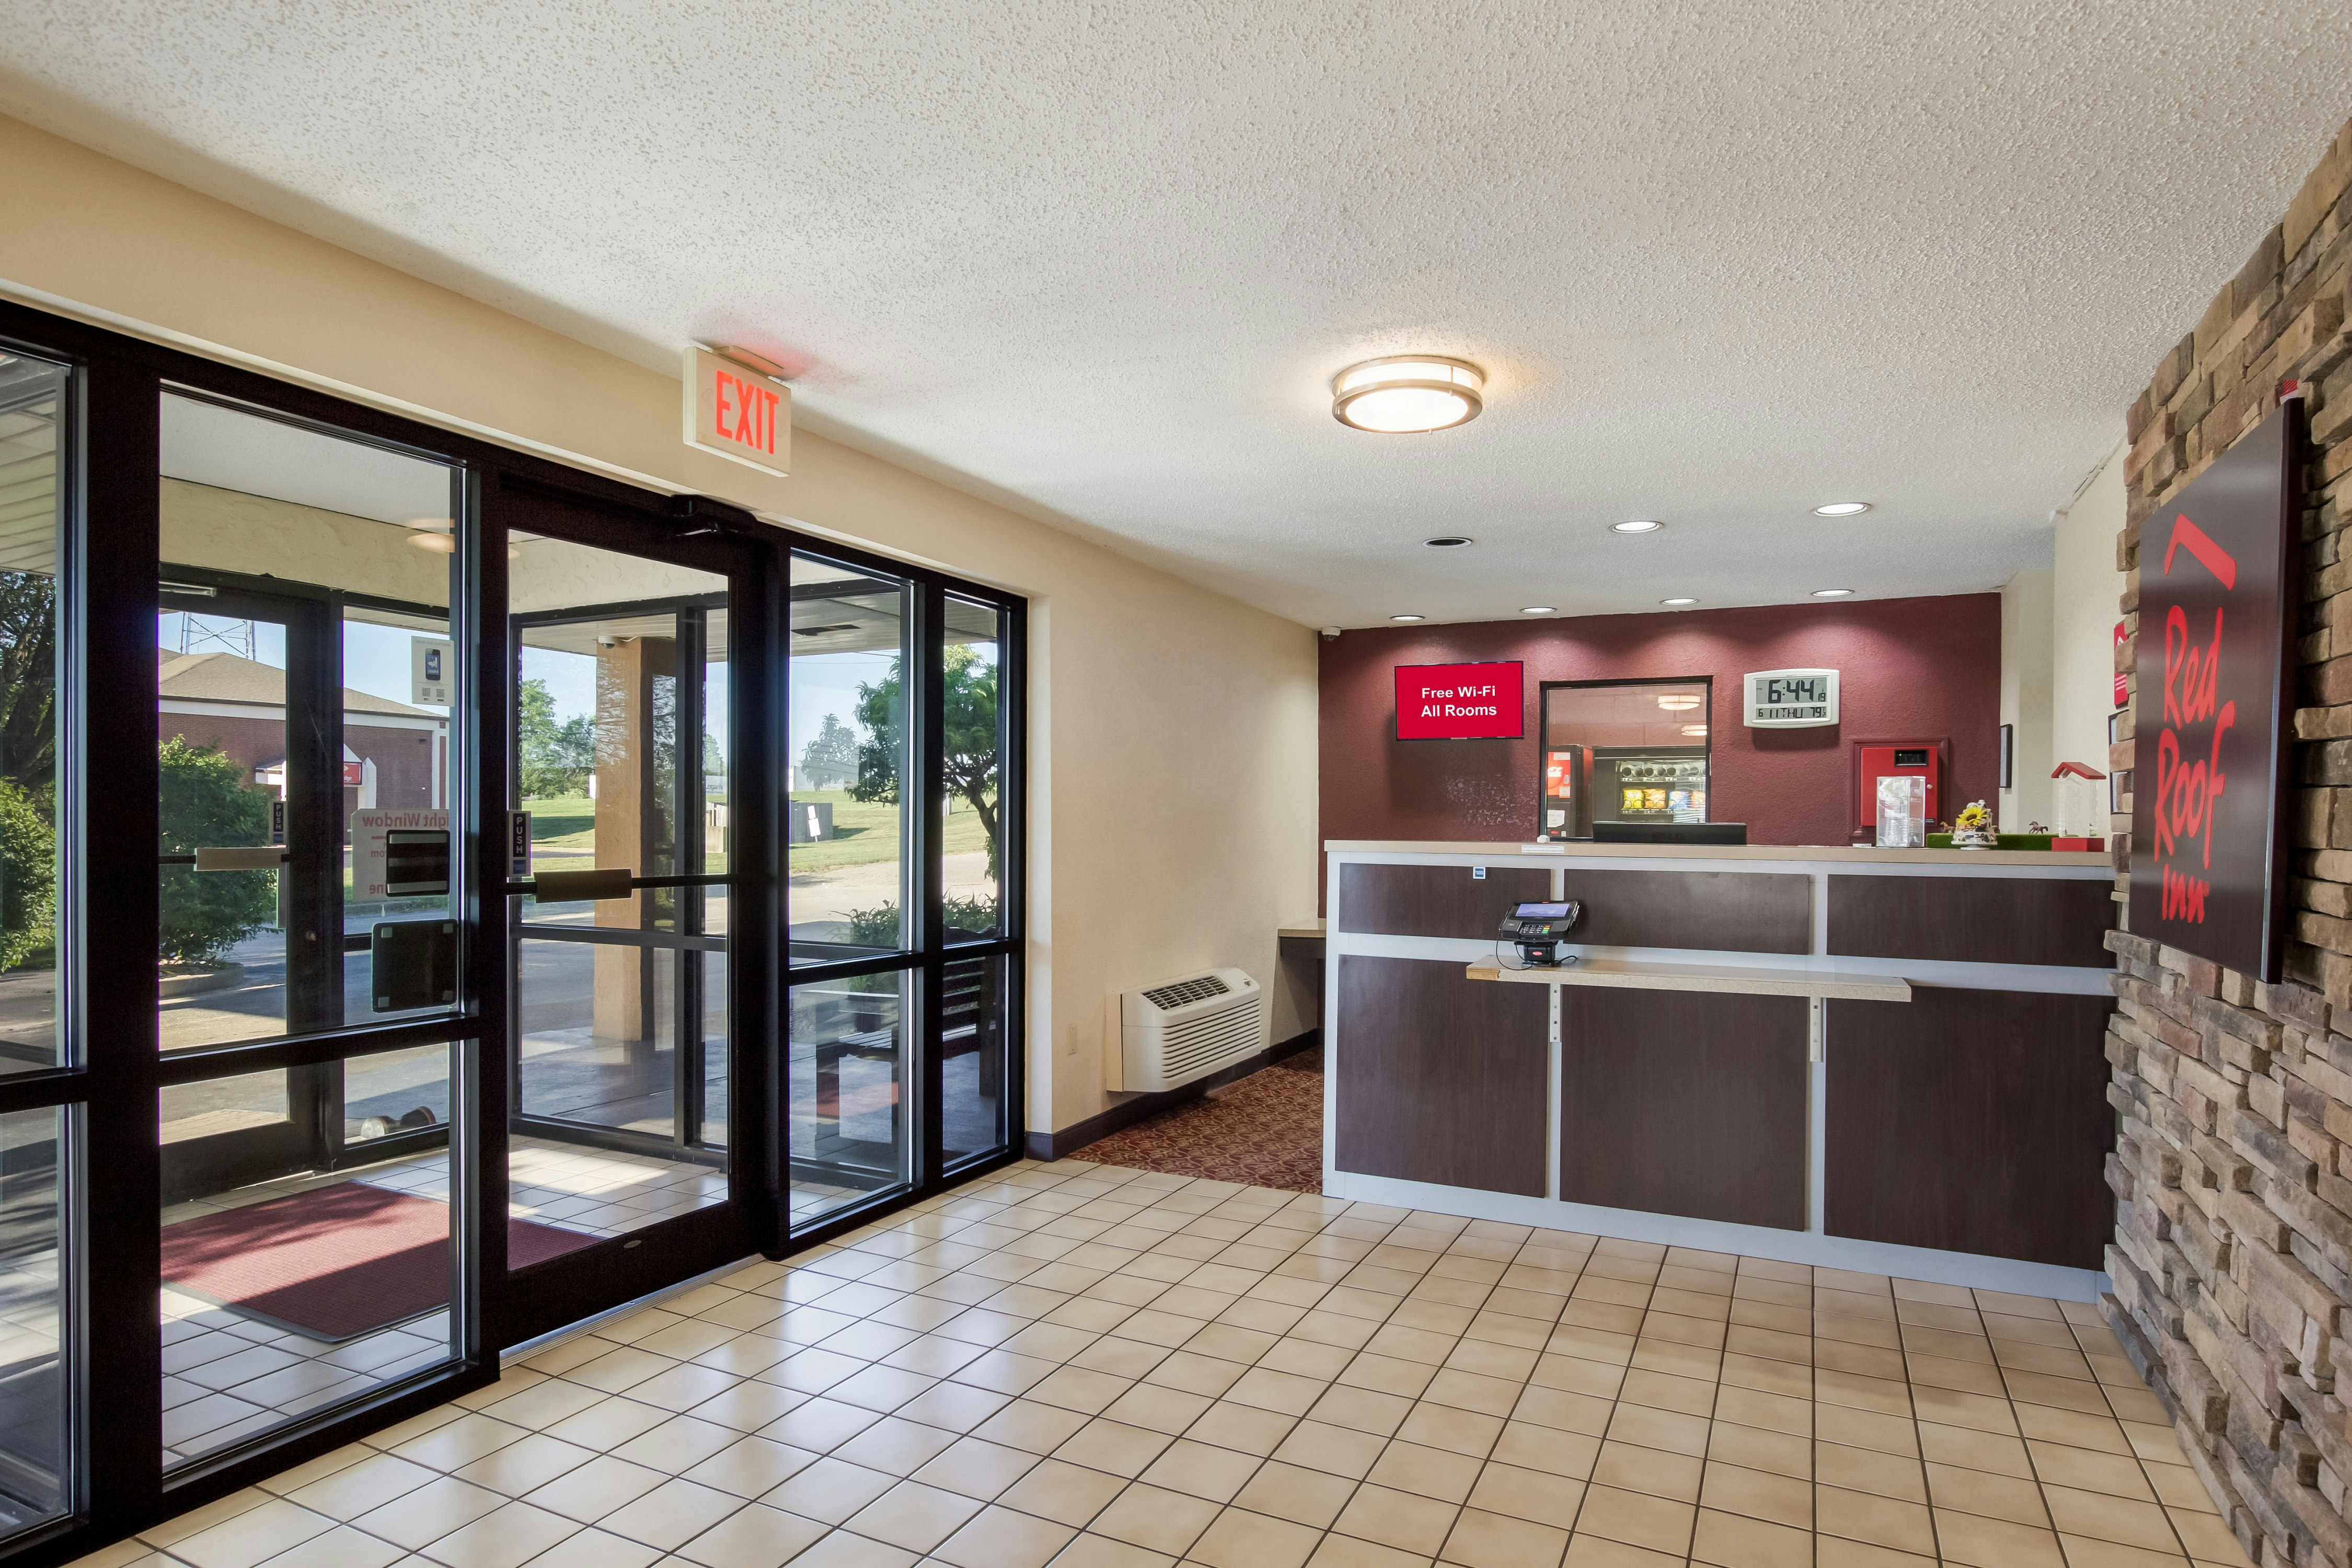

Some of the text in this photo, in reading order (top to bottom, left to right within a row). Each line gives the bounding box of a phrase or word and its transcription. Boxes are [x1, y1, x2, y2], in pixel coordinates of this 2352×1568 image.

[716, 370, 780, 455] EXIT
[2163, 605, 2223, 730] Red
[1422, 685, 1495, 698] Free Wi-Fi
[1768, 679, 1826, 704] 6:44 19
[1421, 704, 1497, 717] All Rooms
[1758, 708, 1763, 717] 6
[1770, 708, 1779, 718] 11
[1781, 708, 1803, 719] THU
[2154, 700, 2235, 870] Roof
